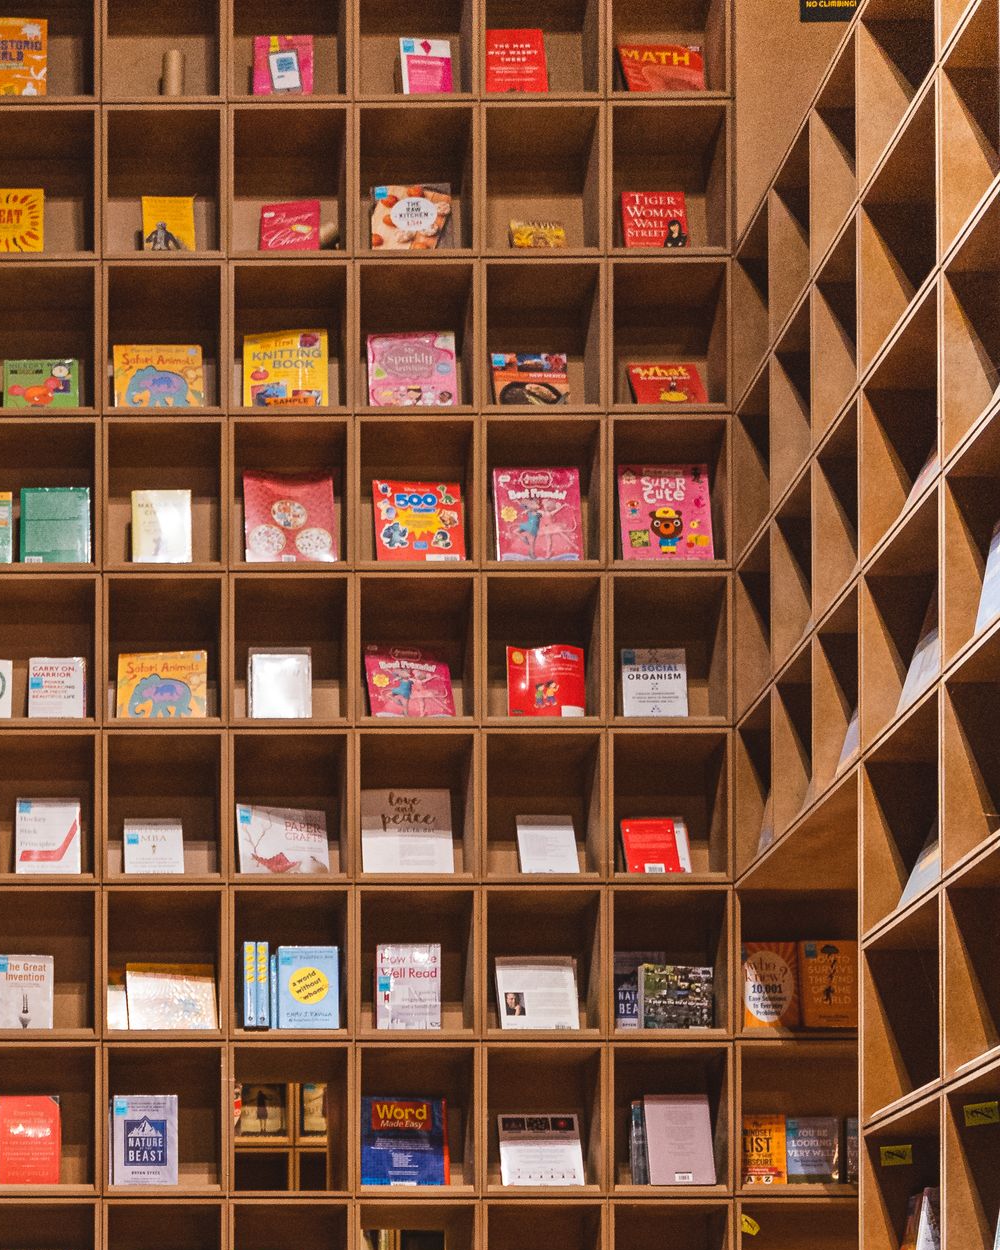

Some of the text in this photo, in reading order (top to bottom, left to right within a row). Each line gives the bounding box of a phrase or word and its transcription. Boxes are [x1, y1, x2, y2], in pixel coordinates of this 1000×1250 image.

[620, 47, 690, 66] MATH
[630, 194, 676, 207] TIGER
[398, 212, 430, 220] KITCHEN
[626, 206, 684, 220] WOMAN
[634, 219, 665, 230] WALL
[627, 227, 666, 238] STREET
[121, 353, 195, 367] Safari Animals
[252, 349, 322, 361] KNITTING
[386, 352, 435, 368] Sparkly
[272, 358, 315, 369] BOOK
[638, 366, 689, 379] What
[394, 494, 437, 507] 500
[127, 660, 200, 675] Safari Animals
[284, 820, 321, 834] PAPER
[381, 811, 436, 831] peace
[284, 832, 323, 843] CRAFTS
[5, 962, 46, 973] The Great
[407, 966, 437, 979] Read
[5, 971, 46, 982] Invention
[752, 983, 782, 995] 10,001
[375, 1103, 428, 1121] Word
[743, 1137, 771, 1153] LIST
[128, 1150, 163, 1162] BEAST
